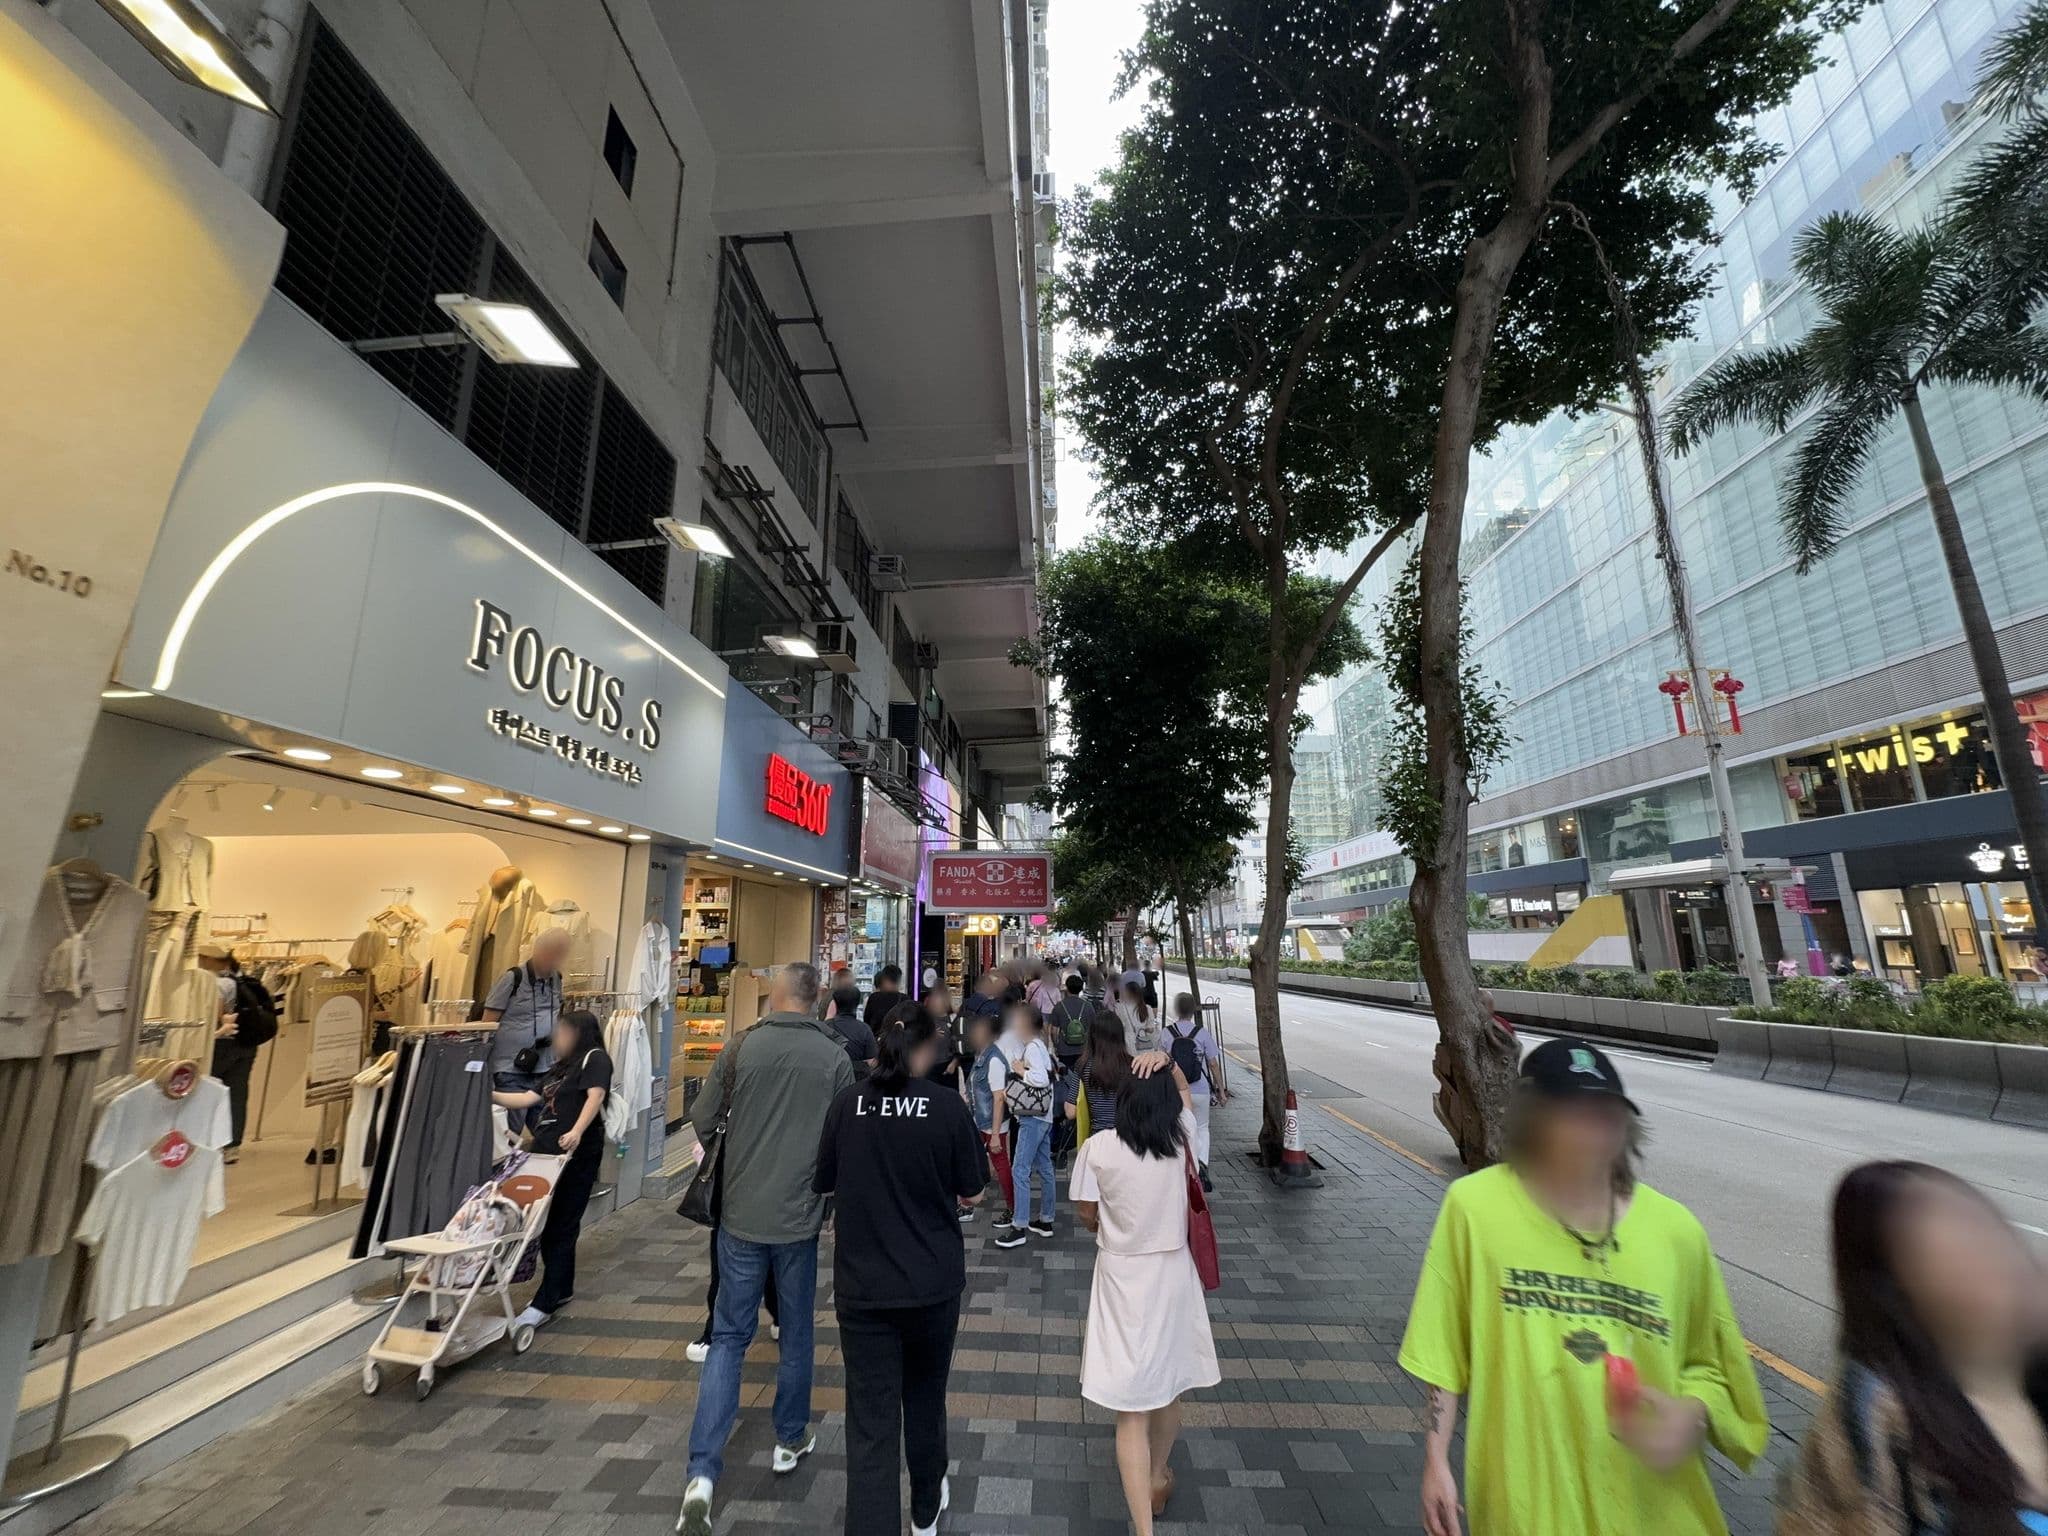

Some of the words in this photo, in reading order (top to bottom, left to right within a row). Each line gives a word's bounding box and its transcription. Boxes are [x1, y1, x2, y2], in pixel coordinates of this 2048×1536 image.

[5, 549, 92, 598] No.10
[466, 598, 663, 750] FOCUS.S
[940, 866, 976, 877] FANDA
[856, 1095, 930, 1117] LEWE
